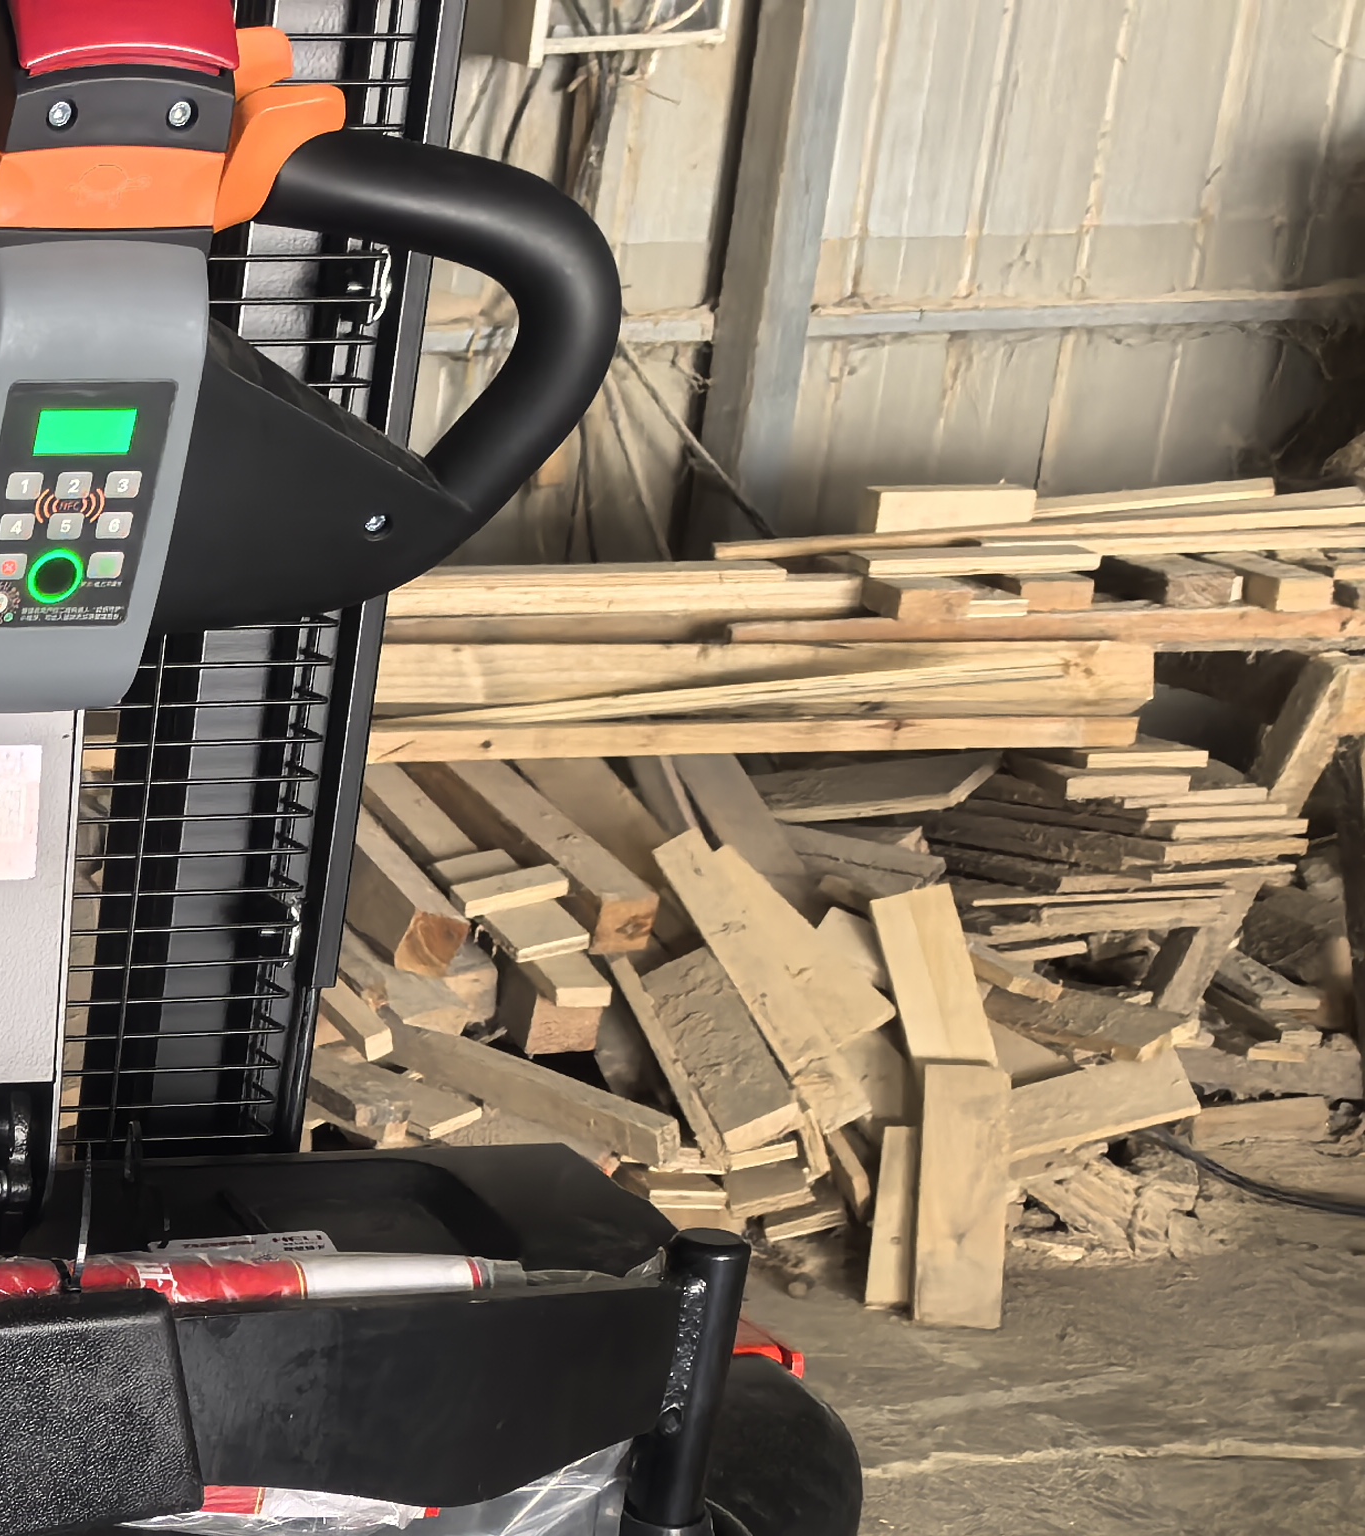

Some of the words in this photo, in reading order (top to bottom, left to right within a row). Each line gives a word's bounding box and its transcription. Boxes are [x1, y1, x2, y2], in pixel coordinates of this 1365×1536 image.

[20, 478, 31, 494] 1
[68, 478, 80, 494] 2
[117, 478, 130, 493] 3
[58, 501, 80, 511] NFC
[9, 519, 23, 535] 4
[59, 518, 72, 534] 5
[108, 518, 121, 533] 6
